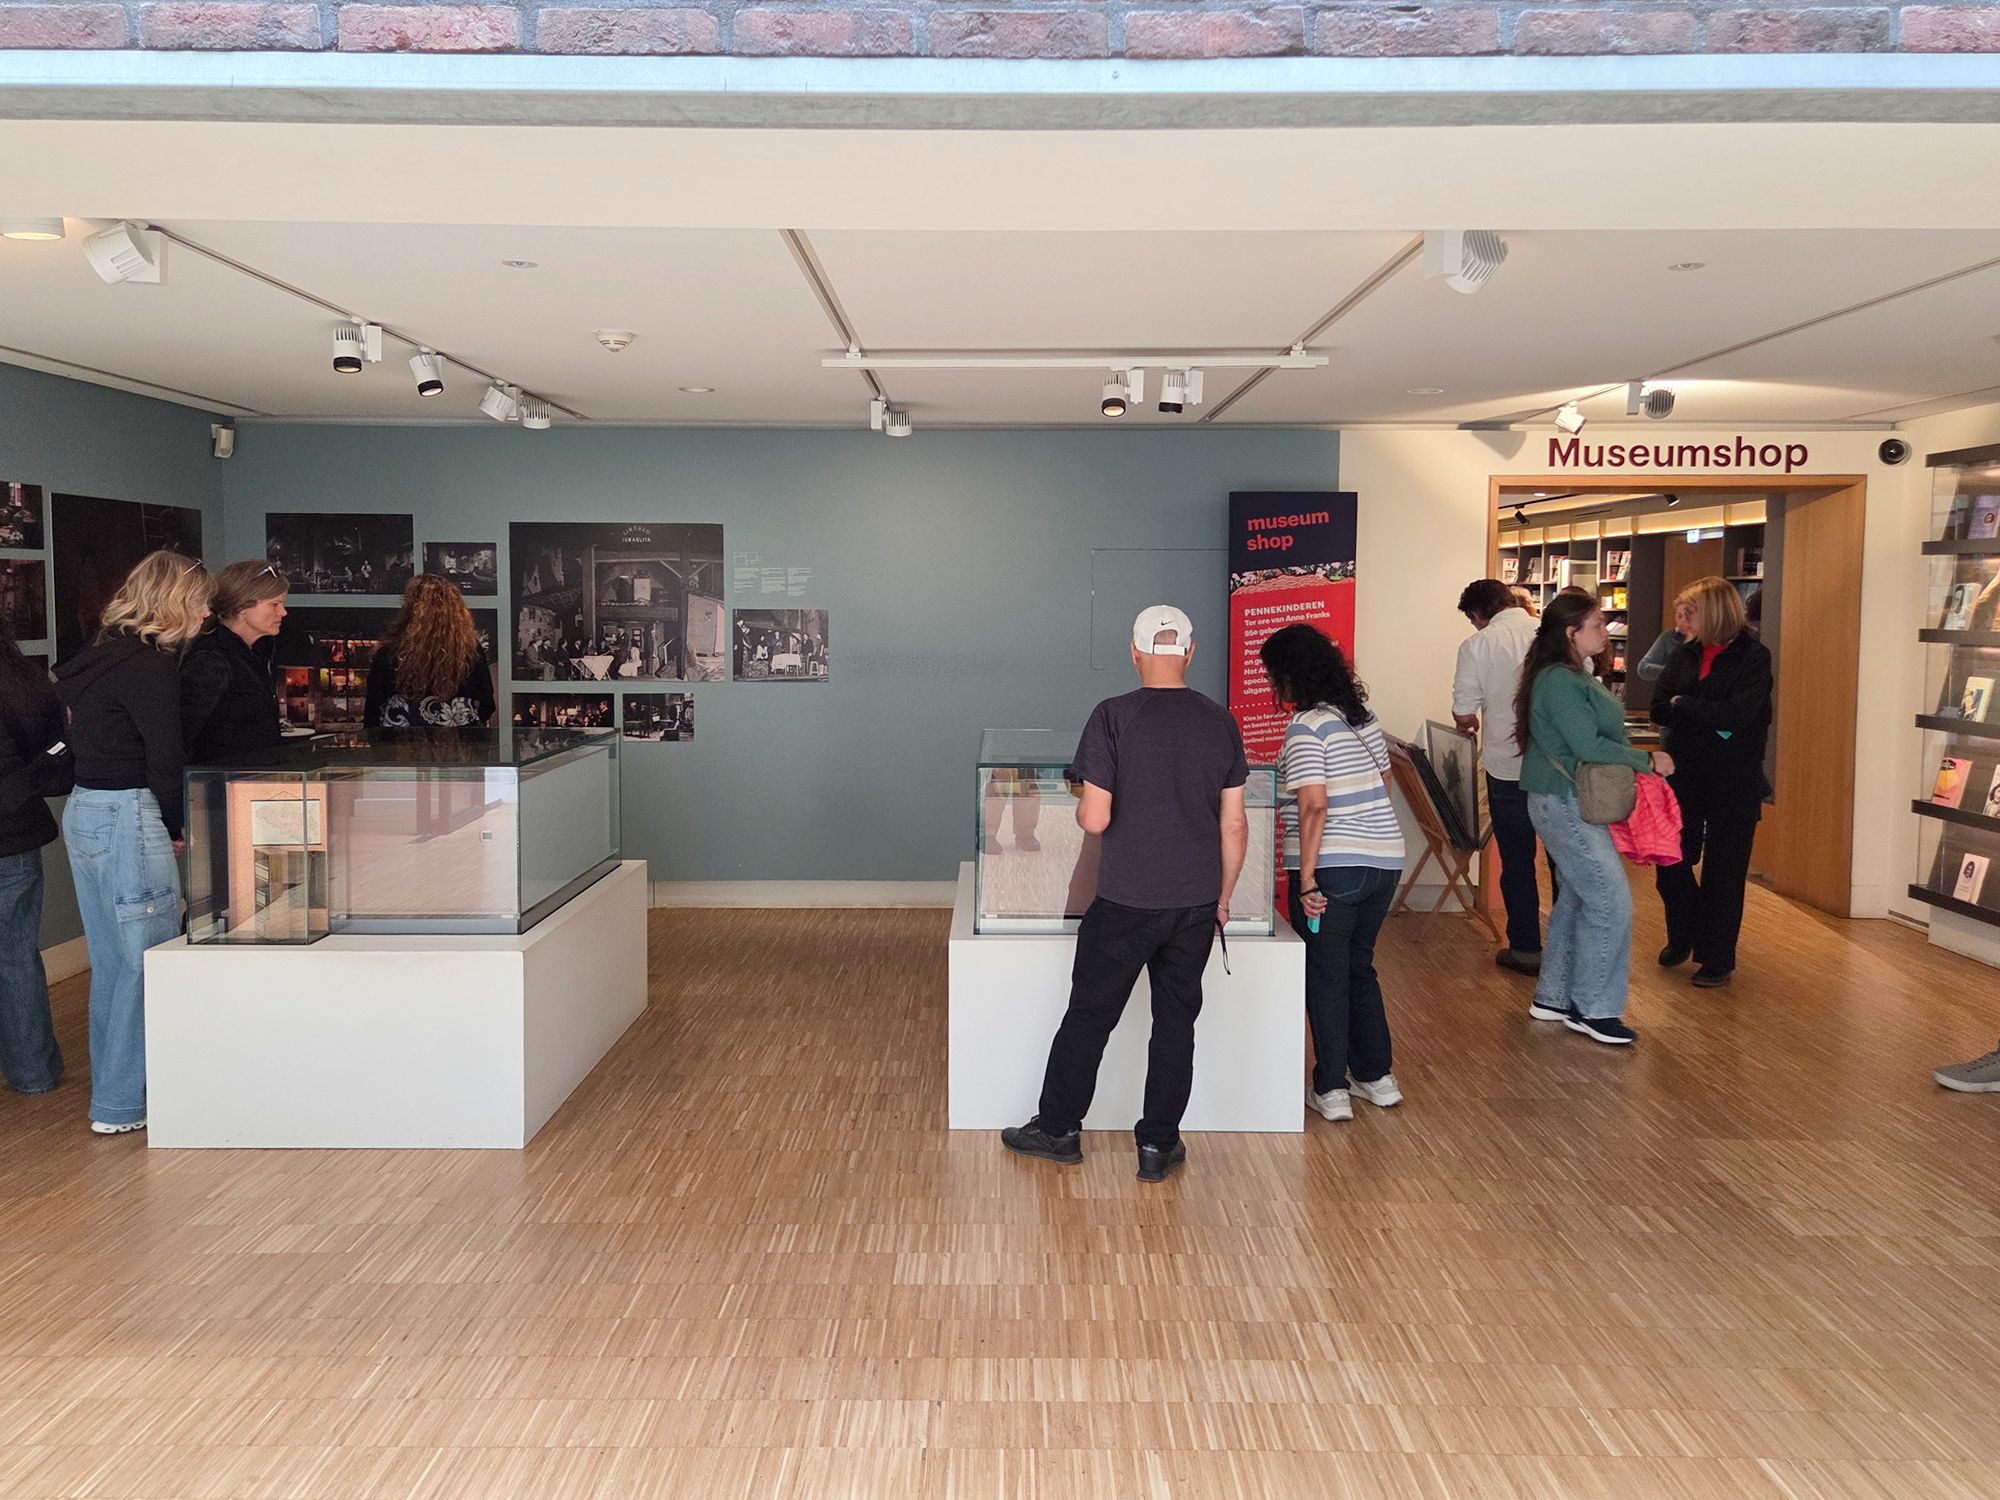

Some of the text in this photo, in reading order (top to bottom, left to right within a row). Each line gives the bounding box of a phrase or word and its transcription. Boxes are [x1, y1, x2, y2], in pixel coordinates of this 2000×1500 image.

[1548, 436, 1808, 473] Museumshop
[1247, 511, 1330, 531] museum
[1246, 534, 1295, 551] shop
[1244, 601, 1325, 617] PENNEKINDEREN
[1271, 616, 1285, 624] van
[1285, 614, 1305, 622] Anne
[1305, 611, 1331, 620] Franks
[1243, 668, 1257, 676] Het
[1243, 687, 1271, 695] uitgave
